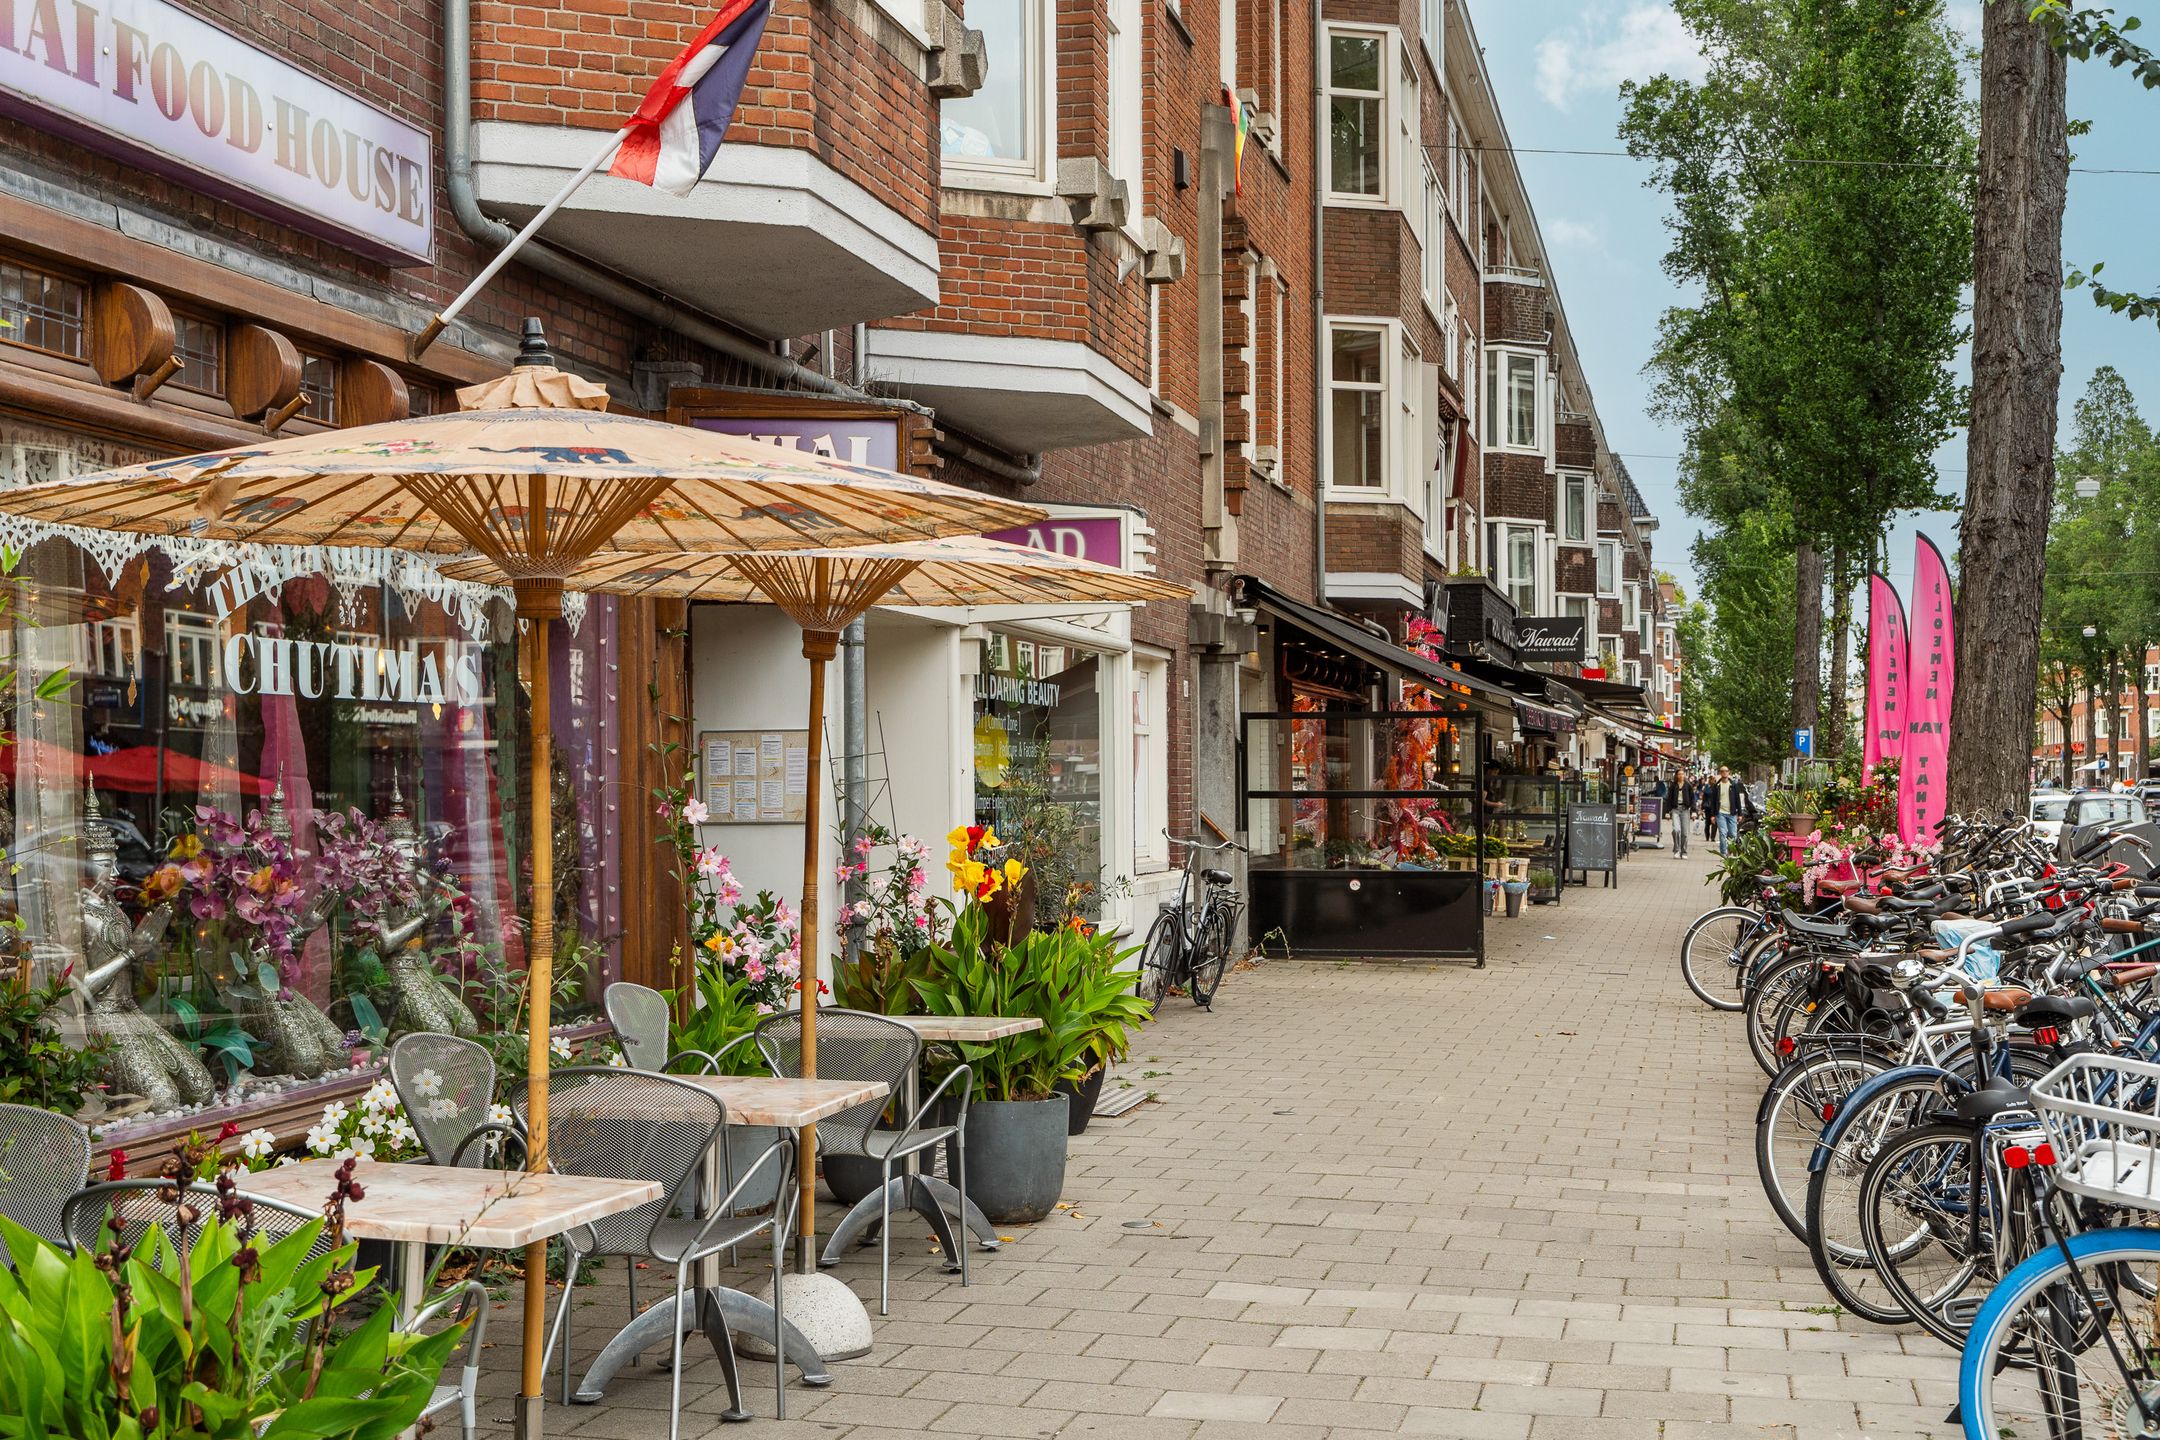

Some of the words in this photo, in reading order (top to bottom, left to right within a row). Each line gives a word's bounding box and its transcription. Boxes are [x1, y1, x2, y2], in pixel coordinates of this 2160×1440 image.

[112, 18, 263, 154] FOOD
[273, 95, 425, 228] HOUSE
[1517, 626, 1583, 648] Nawaab
[223, 631, 479, 707] CHUTIMA'S
[989, 674, 1025, 704] DARING
[1027, 680, 1060, 708] BEAUTY
[1799, 736, 1806, 747] P
